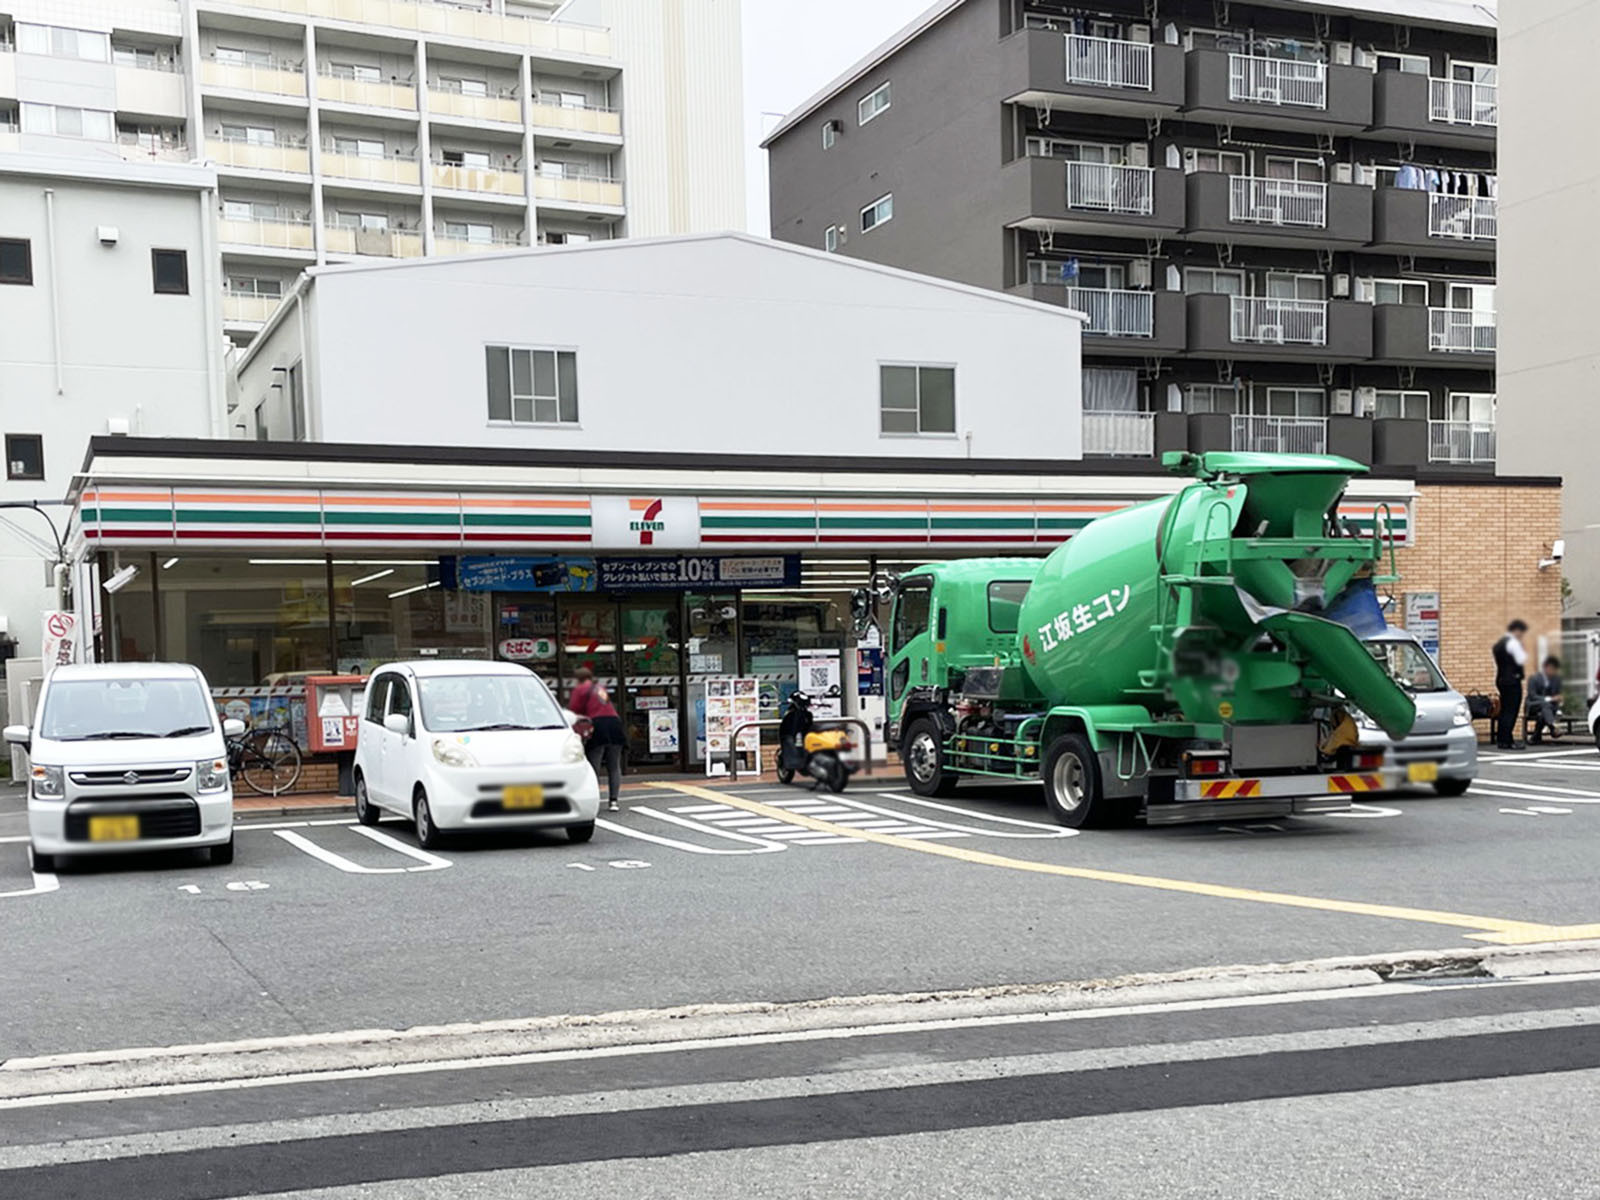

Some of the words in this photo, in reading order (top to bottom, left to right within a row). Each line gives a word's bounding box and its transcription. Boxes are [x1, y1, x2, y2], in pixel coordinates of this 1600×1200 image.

[1037, 584, 1131, 653] 江坂生コン
[505, 641, 533, 654] たばこ
